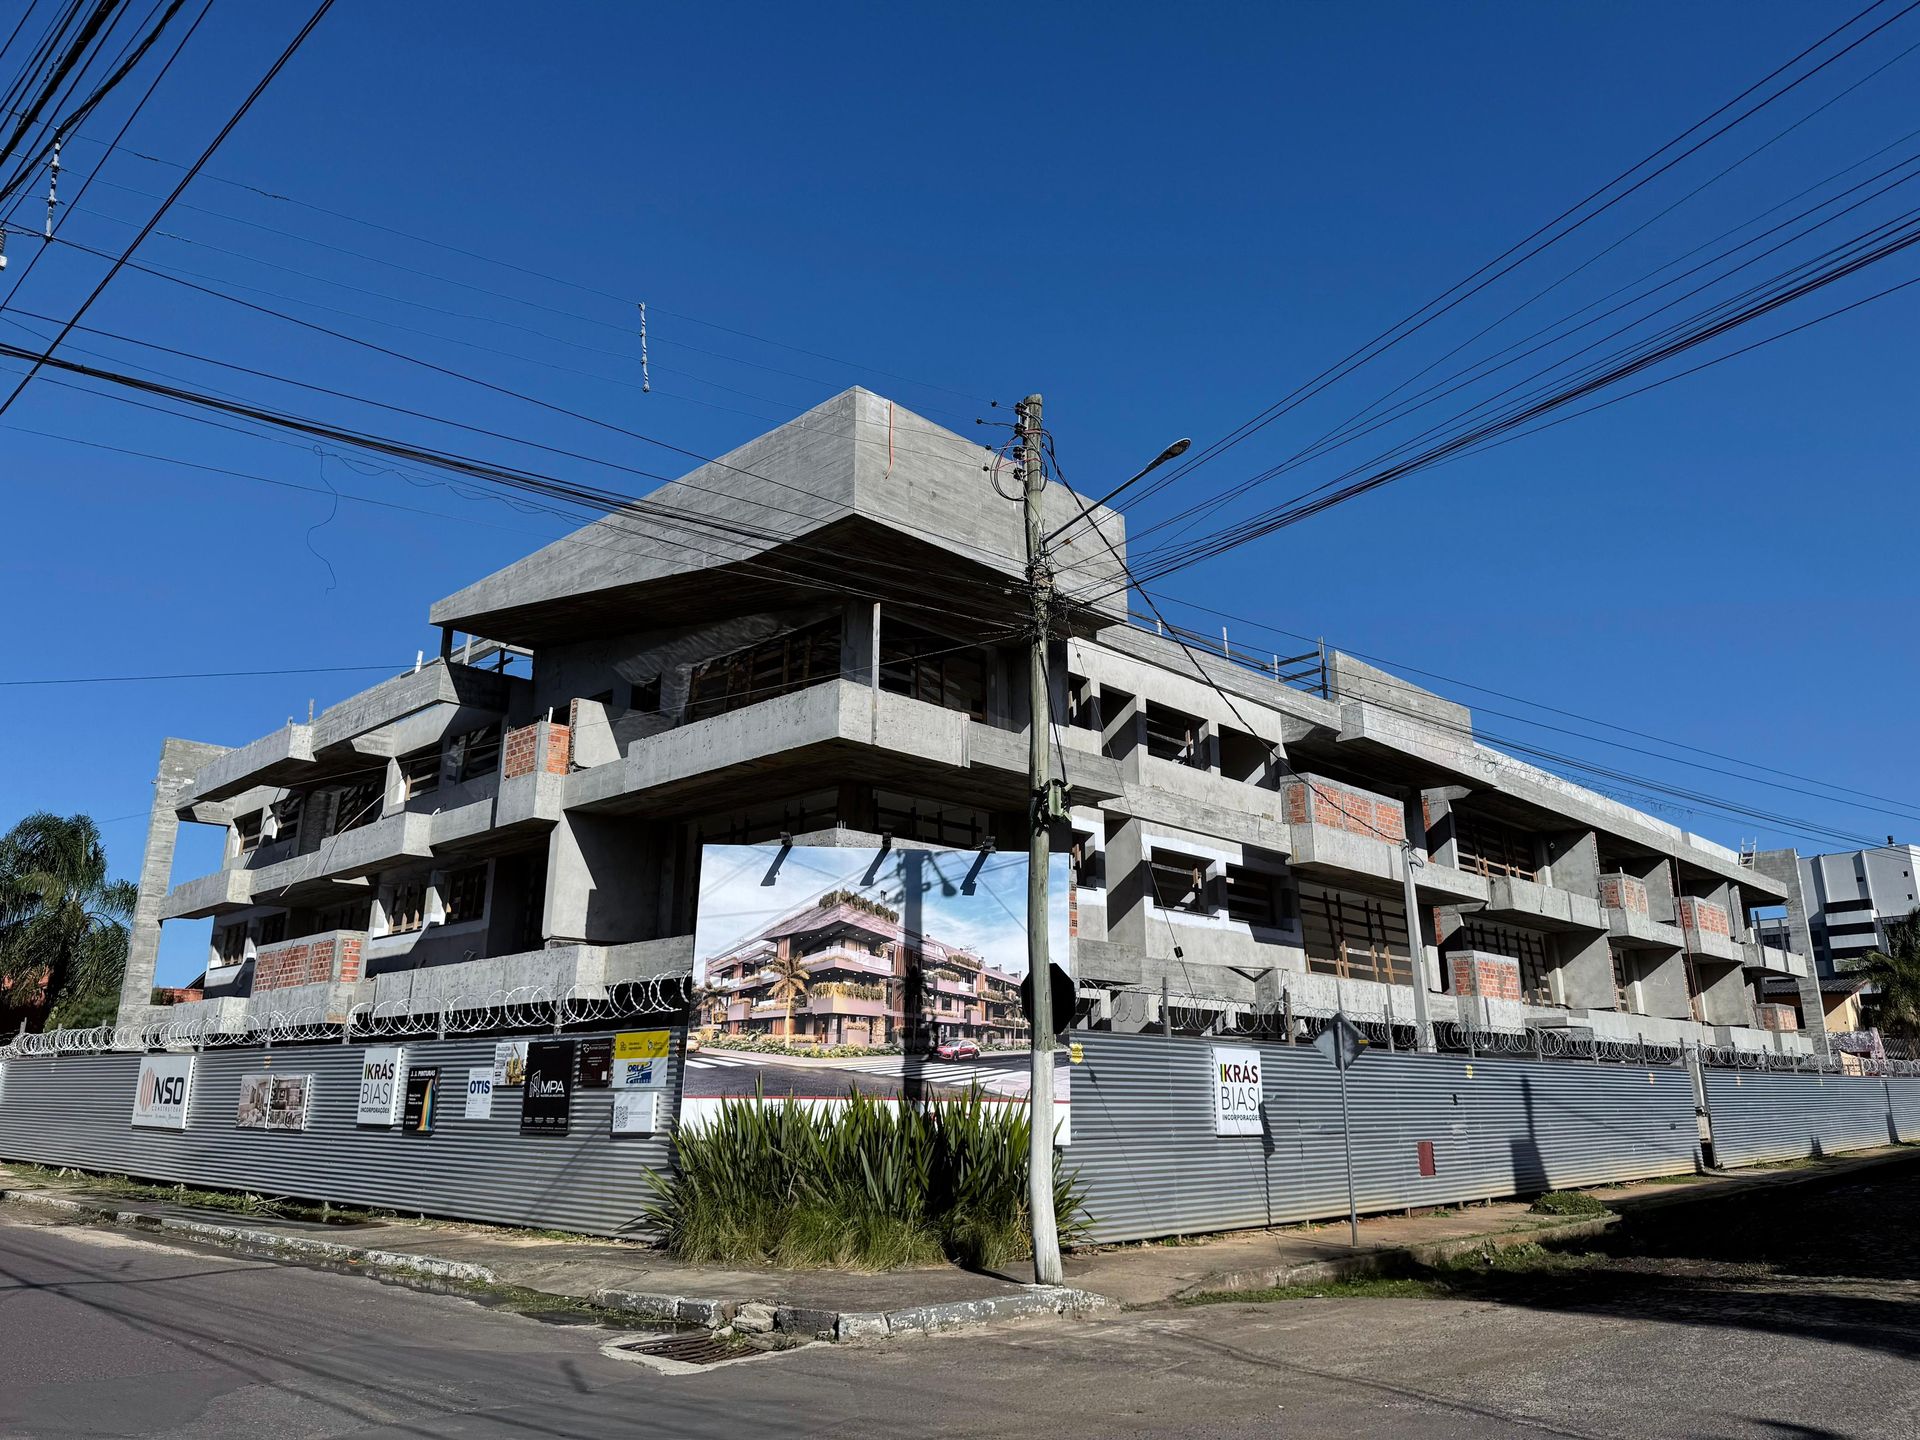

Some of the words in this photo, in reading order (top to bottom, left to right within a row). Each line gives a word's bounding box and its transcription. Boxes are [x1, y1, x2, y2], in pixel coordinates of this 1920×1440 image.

[153, 1076, 185, 1105] NSO
[361, 1083, 393, 1105] BIASI
[470, 1080, 491, 1095] OTIS
[540, 1080, 565, 1094] MPA
[1221, 1086, 1260, 1112] BIASI
[1222, 1113, 1261, 1122] INCORPORAÇÕES
